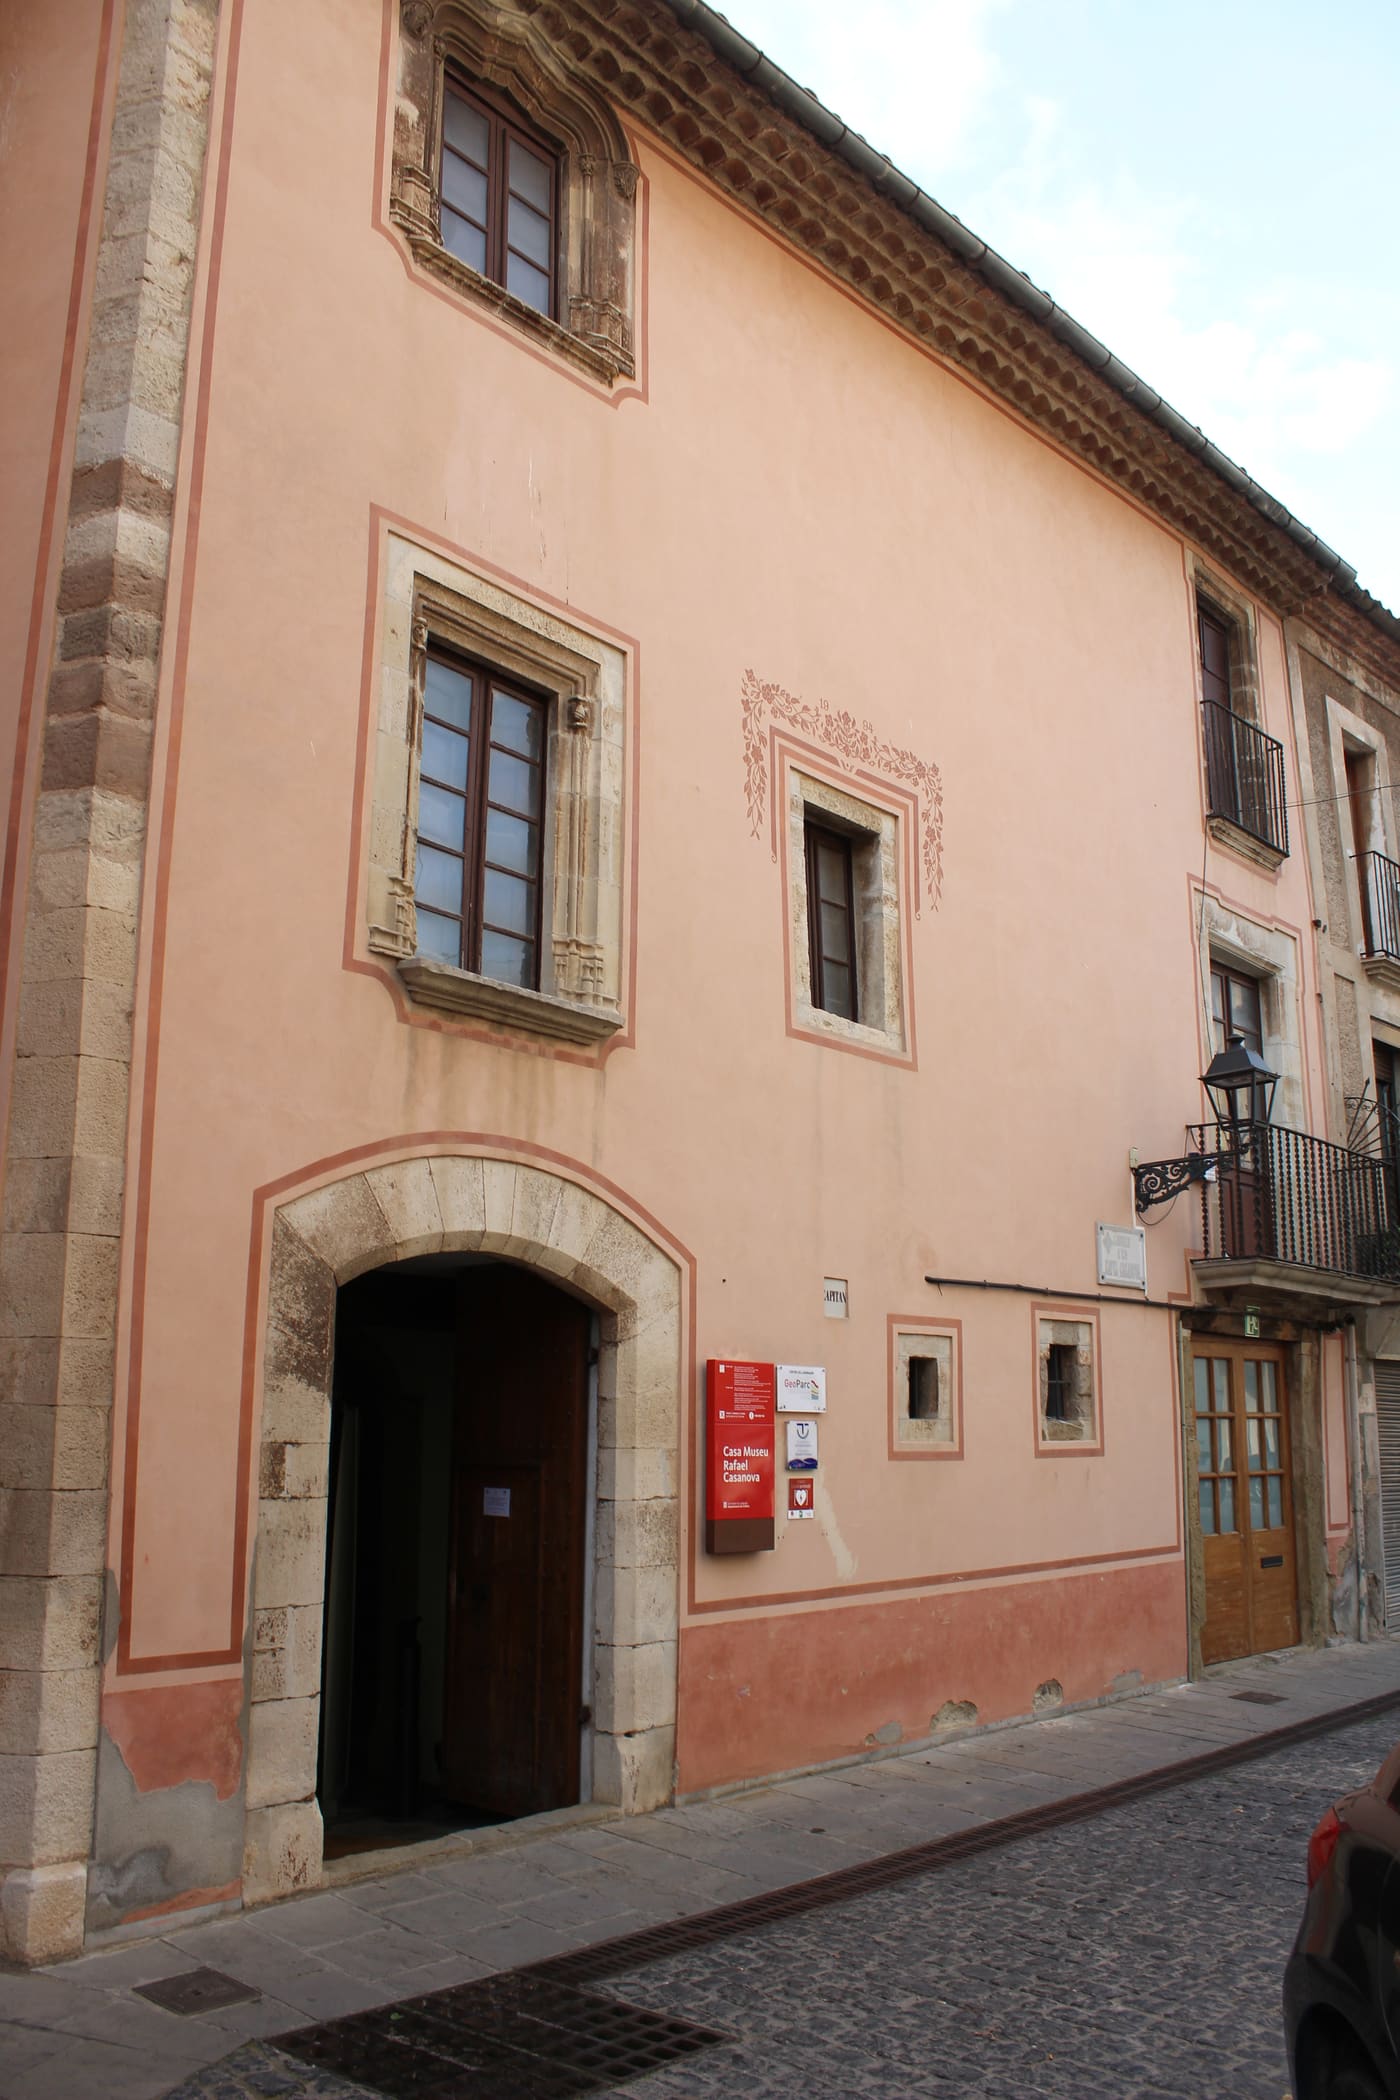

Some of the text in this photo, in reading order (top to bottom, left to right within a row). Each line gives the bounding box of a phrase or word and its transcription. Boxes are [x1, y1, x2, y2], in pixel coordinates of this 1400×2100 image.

[784, 1379, 810, 1389] GeoParc
[723, 1446, 769, 1457] Casa Museu
[723, 1459, 749, 1471] Rafael
[723, 1472, 761, 1483] Casanova
